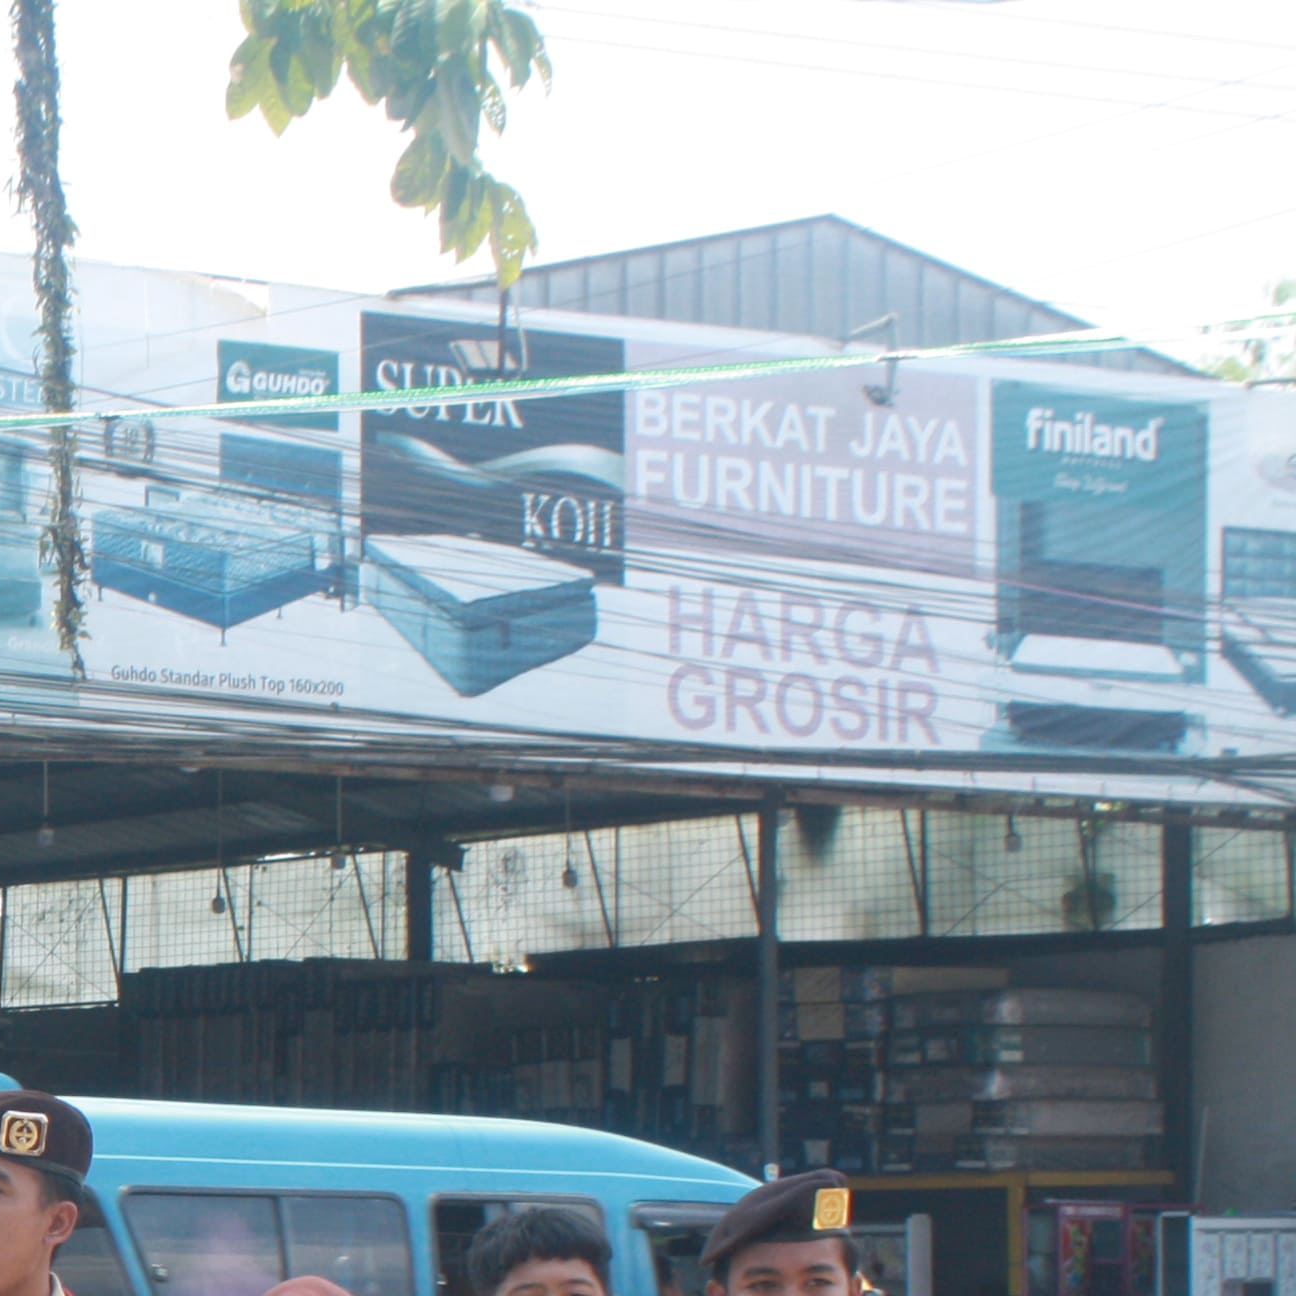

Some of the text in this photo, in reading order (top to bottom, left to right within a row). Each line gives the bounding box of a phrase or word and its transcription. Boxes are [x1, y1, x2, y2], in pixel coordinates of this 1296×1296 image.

[252, 371, 328, 396] GUHDO
[635, 390, 969, 468] BERKAT JAYA
[1026, 406, 1165, 463] finiland
[635, 448, 970, 534] FURNITURE
[667, 583, 942, 676] HARGA
[111, 664, 345, 697] Guhdo Standar Plush Top 160x200
[666, 663, 943, 747] GROSIR
